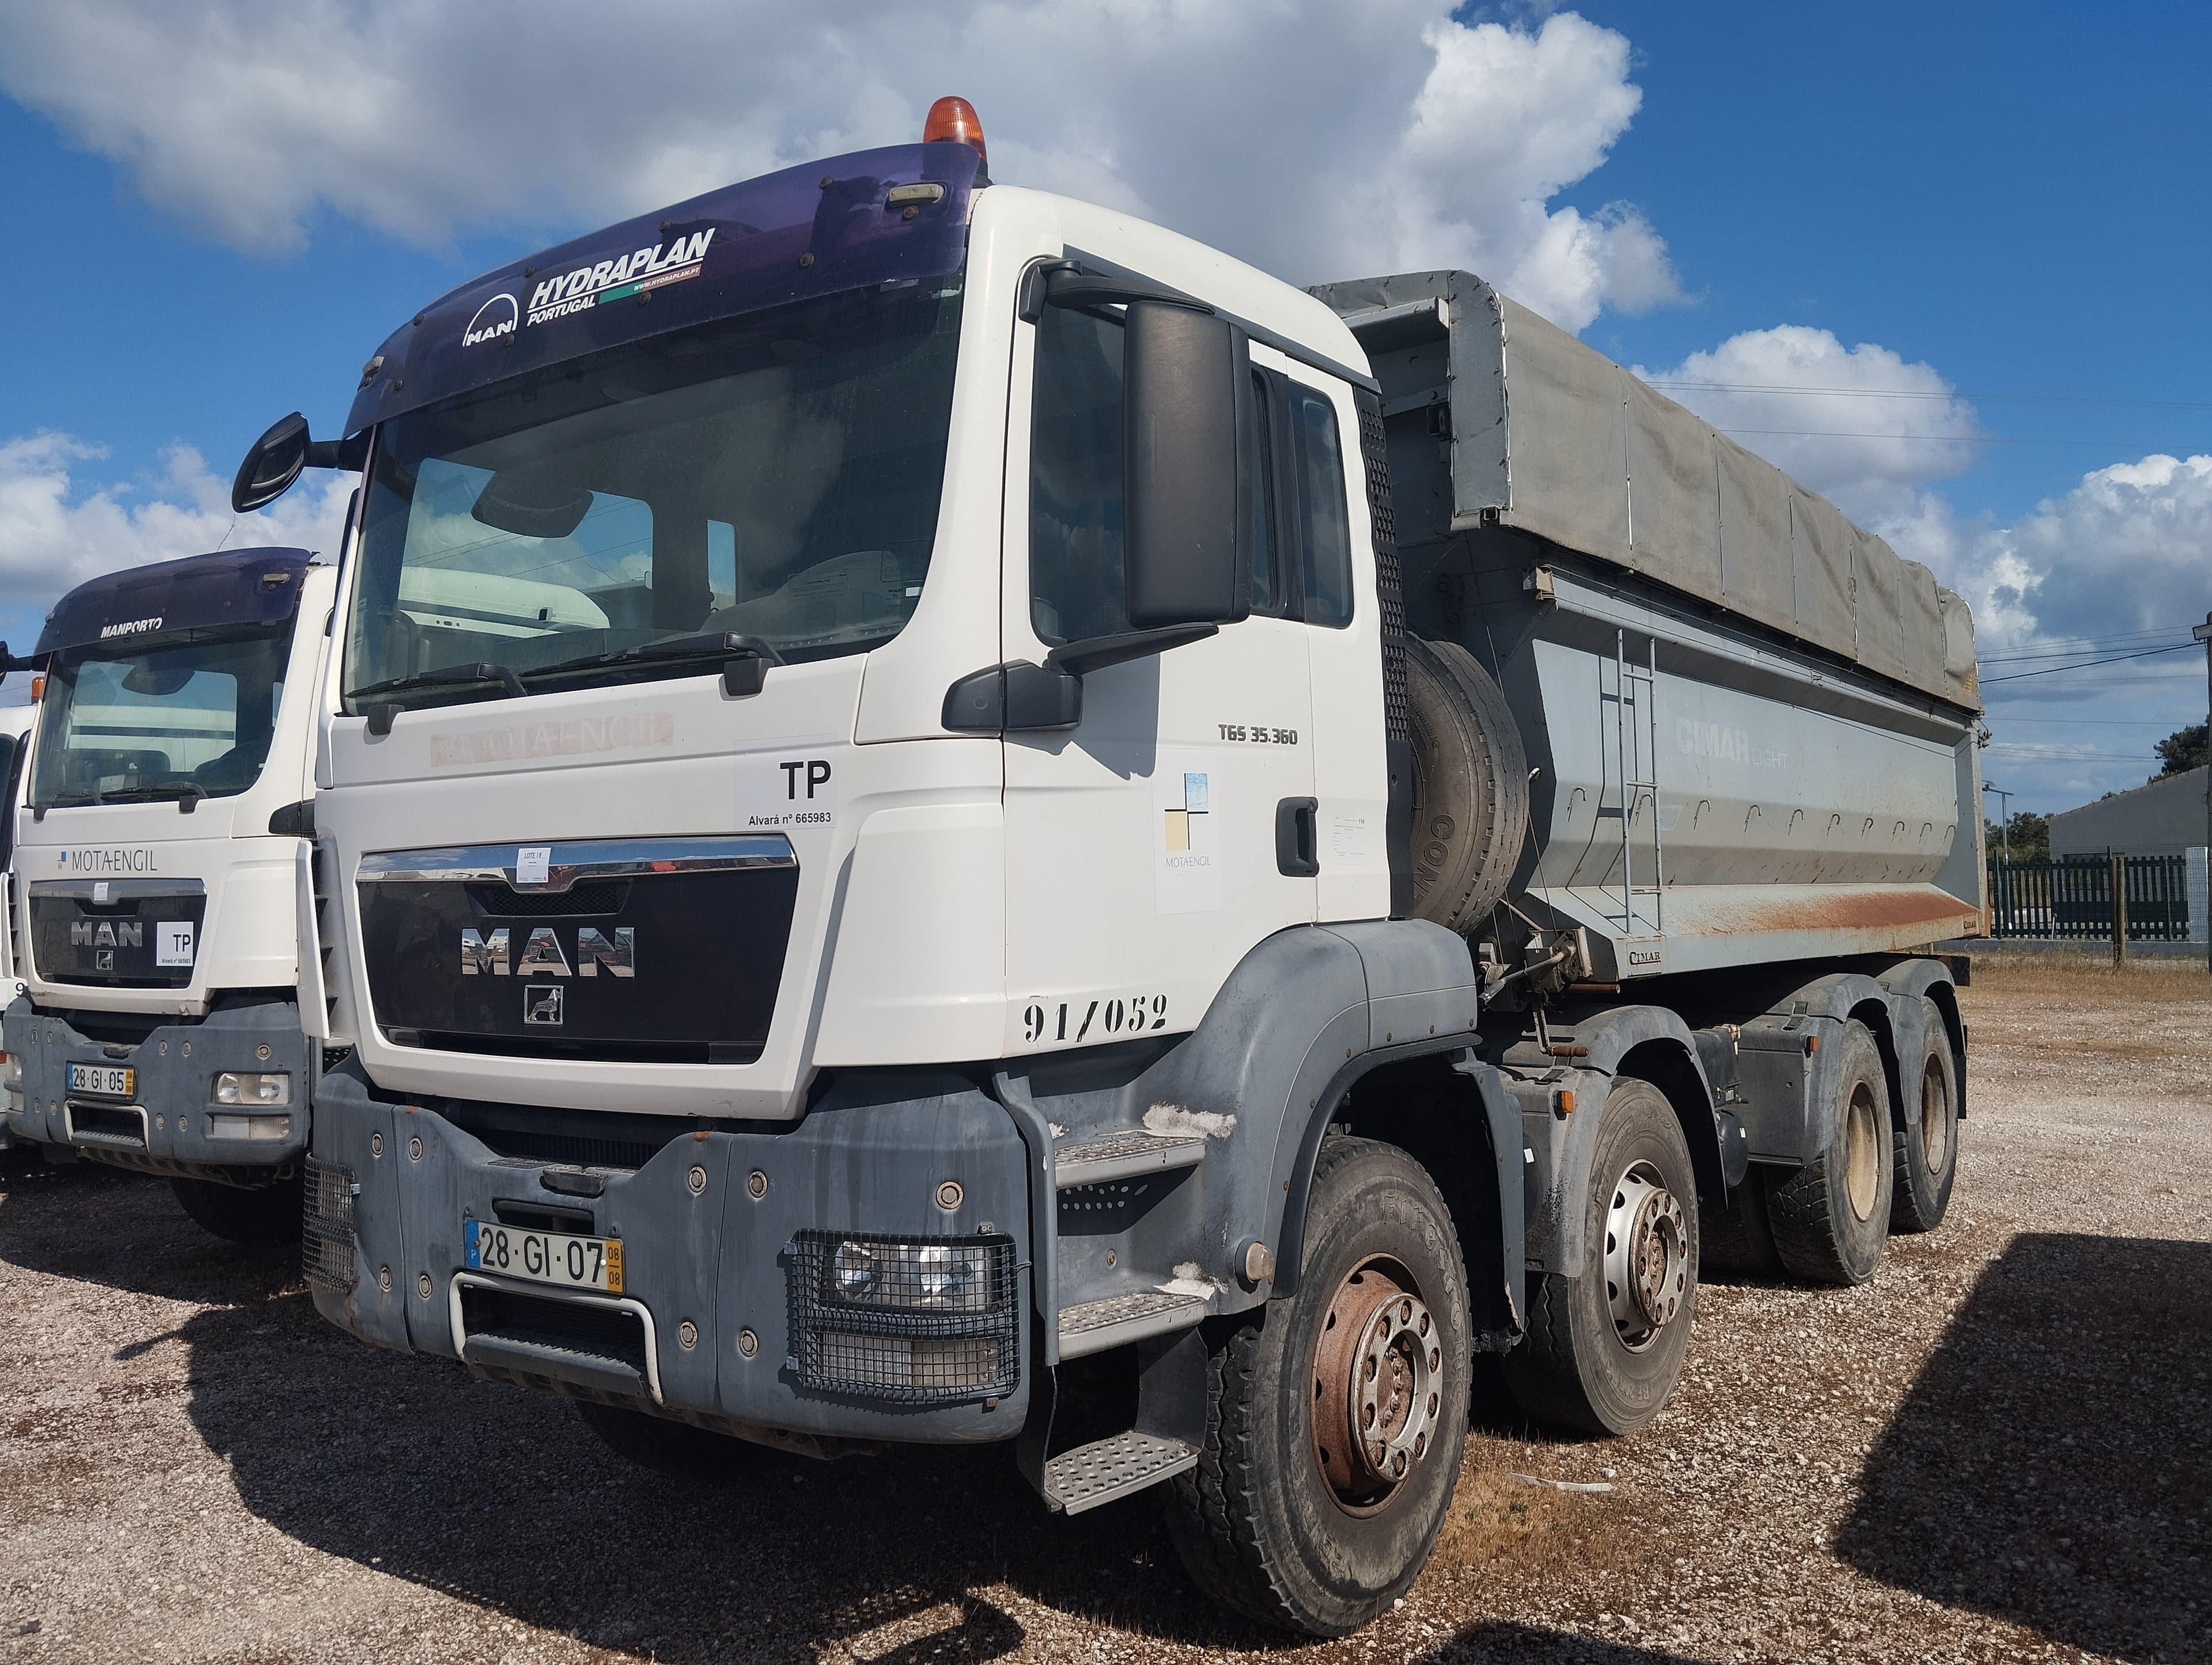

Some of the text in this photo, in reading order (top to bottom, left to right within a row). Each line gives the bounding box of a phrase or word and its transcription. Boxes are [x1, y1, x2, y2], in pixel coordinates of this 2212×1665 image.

[529, 227, 715, 309] HYDRAPLAN
[634, 267, 700, 291] WWW.HYDRAPLAN.PT
[527, 294, 596, 327] PORTUGAL
[466, 320, 513, 346] MAN
[100, 617, 162, 639] MANPORTO
[1251, 726, 1298, 745] 35.360
[1676, 718, 1789, 769] CIMAR LIGHT
[780, 760, 831, 800] TP
[748, 814, 779, 826] Alvará
[796, 812, 831, 824] 665983
[1414, 814, 1457, 898] CON
[71, 921, 142, 947] MAN
[173, 934, 191, 952] TP
[462, 927, 634, 978] MAN
[1024, 994, 1167, 1044] 91/052
[471, 1250, 477, 1259] P
[608, 1247, 620, 1261] 08
[609, 1271, 620, 1285] 08
